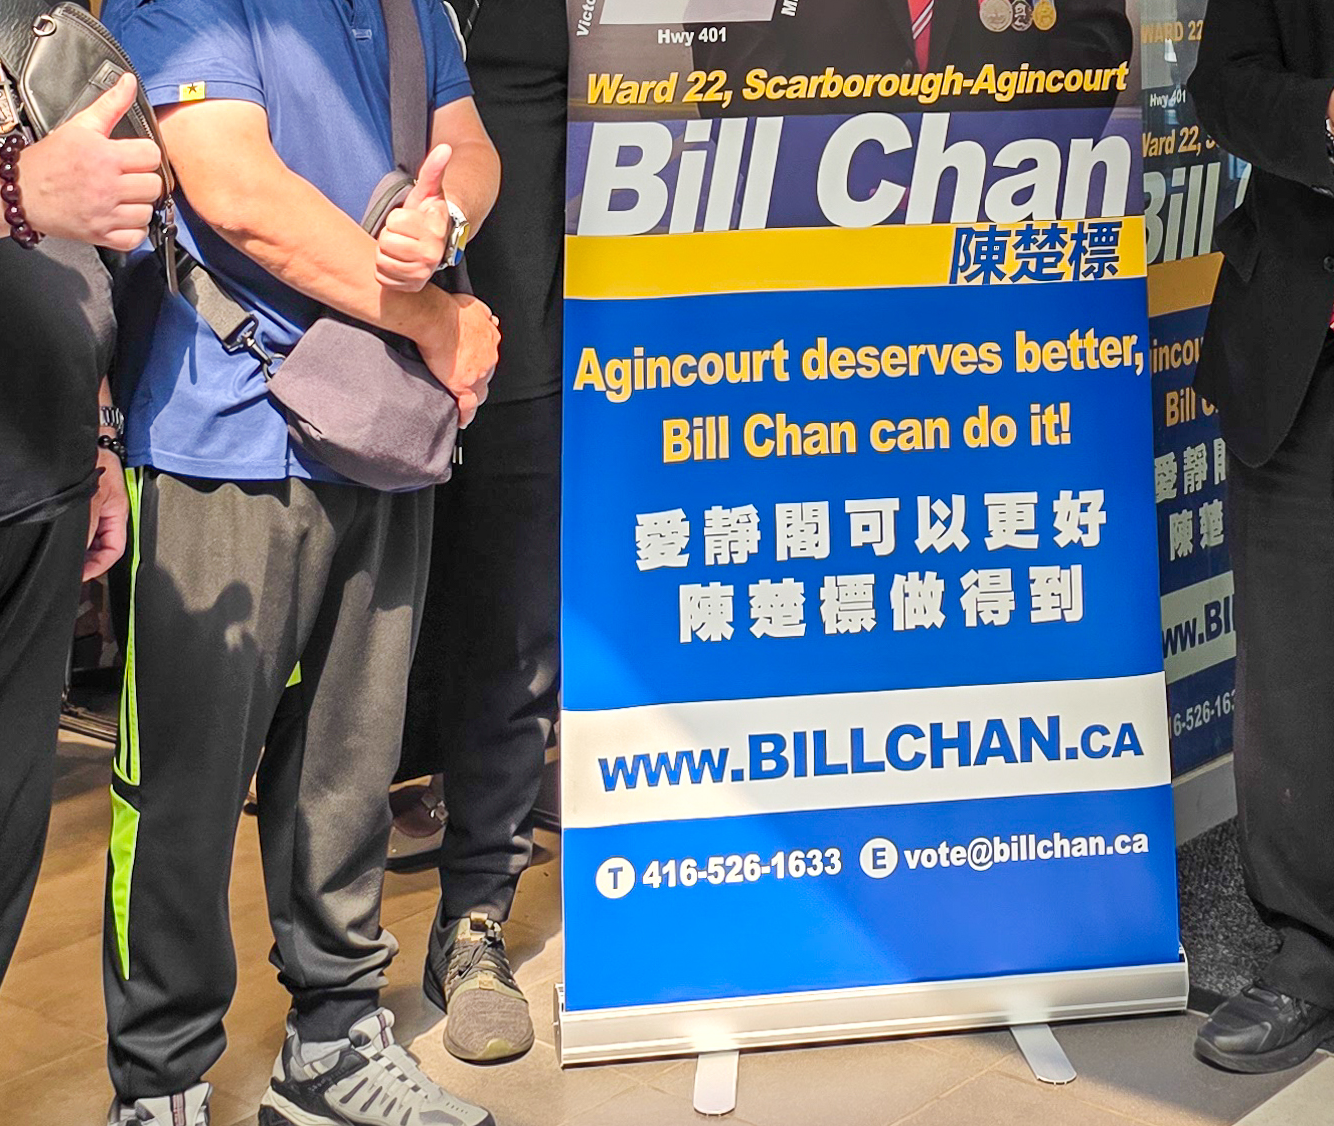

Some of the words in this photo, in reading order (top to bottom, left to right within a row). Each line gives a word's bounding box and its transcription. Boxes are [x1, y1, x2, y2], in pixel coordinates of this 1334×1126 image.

[657, 28, 694, 47] Hwy
[698, 27, 727, 43] 401
[1140, 21, 1184, 44] WARD
[586, 71, 680, 106] Ward
[682, 70, 734, 109] 22,
[741, 61, 1128, 105] Scarborough-Agincourt
[1149, 92, 1169, 109] Hwy
[1177, 125, 1202, 157] 22,
[577, 116, 784, 237] Bill
[816, 111, 1132, 228] Chan
[949, 220, 1123, 284] 陳楚標
[573, 339, 790, 403] Agincourt
[801, 337, 1003, 381] deserves
[1014, 328, 1144, 376] better,
[662, 415, 729, 463] Bill
[743, 413, 858, 458] Chan
[869, 417, 950, 452] can
[963, 405, 1017, 448] do
[1030, 402, 1071, 446] it!
[634, 489, 1107, 571] 愛靜閣可以更好
[678, 564, 1084, 644] 陳楚標做得到
[641, 847, 842, 889] 416-526-1633
[903, 832, 1149, 871] vote@billchan.ca
